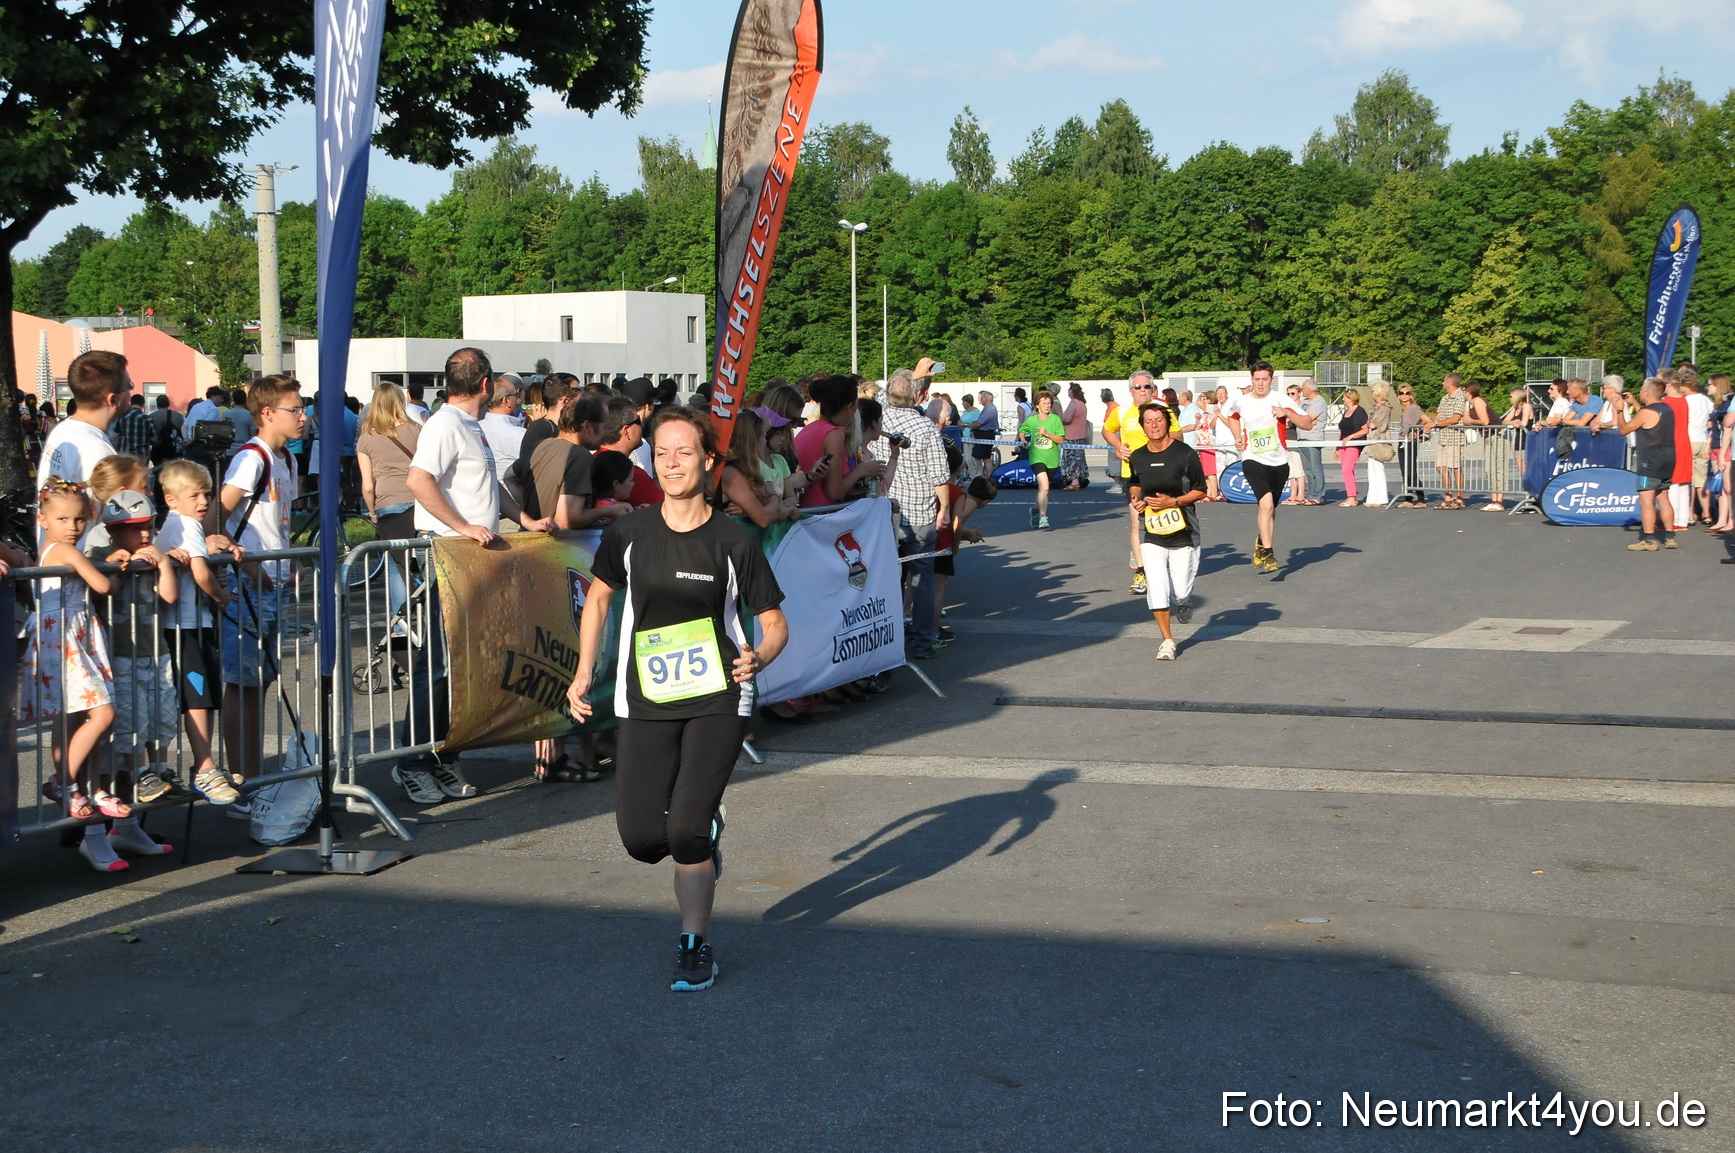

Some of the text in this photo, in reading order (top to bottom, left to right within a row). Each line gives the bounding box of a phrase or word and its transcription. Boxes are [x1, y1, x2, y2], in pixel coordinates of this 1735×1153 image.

[349, 0, 369, 139] AUTO
[1253, 436, 1272, 448] 307
[1569, 492, 1640, 507] Fischer
[1576, 505, 1635, 514] AUTOMOBILE
[1147, 509, 1180, 529] 1110
[832, 617, 894, 664] Lammsbräu
[648, 646, 708, 684] 975
